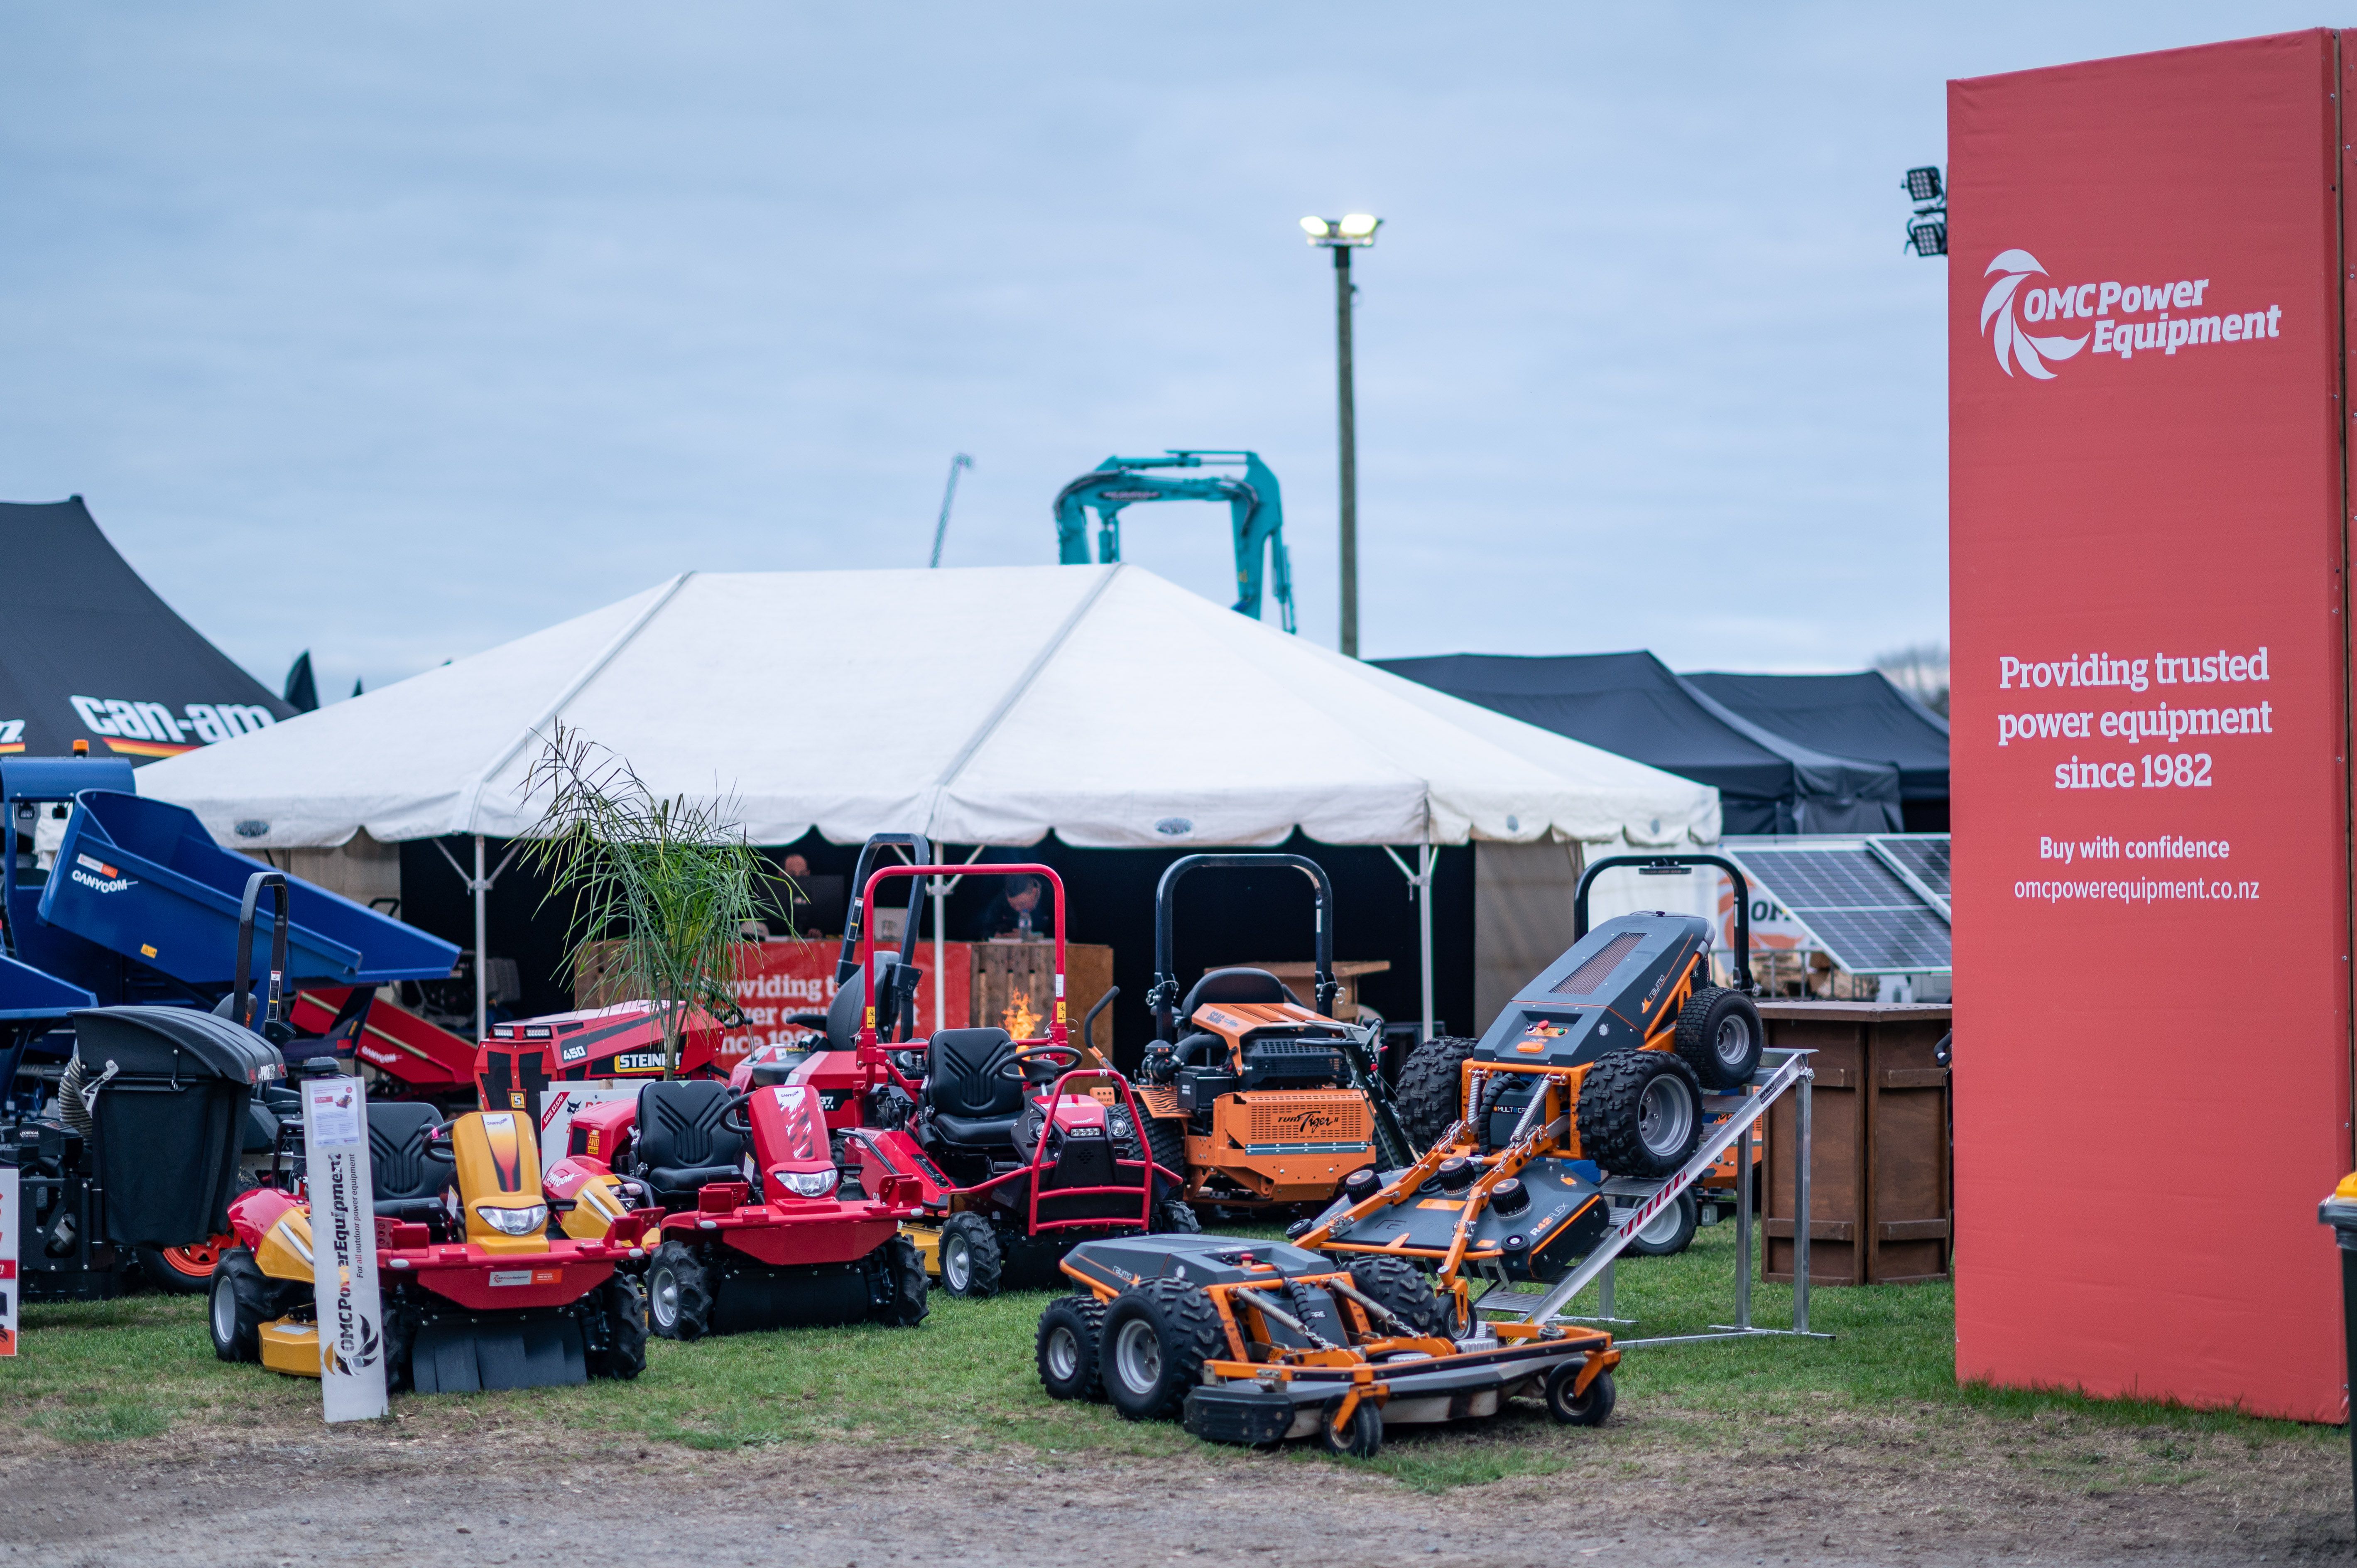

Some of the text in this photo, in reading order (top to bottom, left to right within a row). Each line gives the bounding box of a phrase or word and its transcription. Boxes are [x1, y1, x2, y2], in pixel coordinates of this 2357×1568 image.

[2092, 304, 2282, 359] Equipment
[1999, 647, 2270, 692] Providing trusted
[1998, 701, 2273, 746] power equipment
[2055, 753, 2212, 789] since 1982
[2040, 835, 2230, 864] Buy with confidence
[72, 870, 128, 893] CANYCOM
[2014, 876, 2259, 904] omcpowerequipment.co.nz
[1649, 974, 1665, 999] raymo
[563, 1045, 586, 1060] 450
[1759, 1081, 1774, 1100] HYWAY
[543, 1094, 564, 1124] SAVE $7,570!
[1297, 1110, 1333, 1134] Tiger
[588, 1137, 599, 1147] AWD
[348, 1153, 359, 1195] equipment
[547, 1172, 575, 1187] CANYCOM
[352, 1196, 361, 1221] power
[1112, 1265, 1132, 1280] raymo
